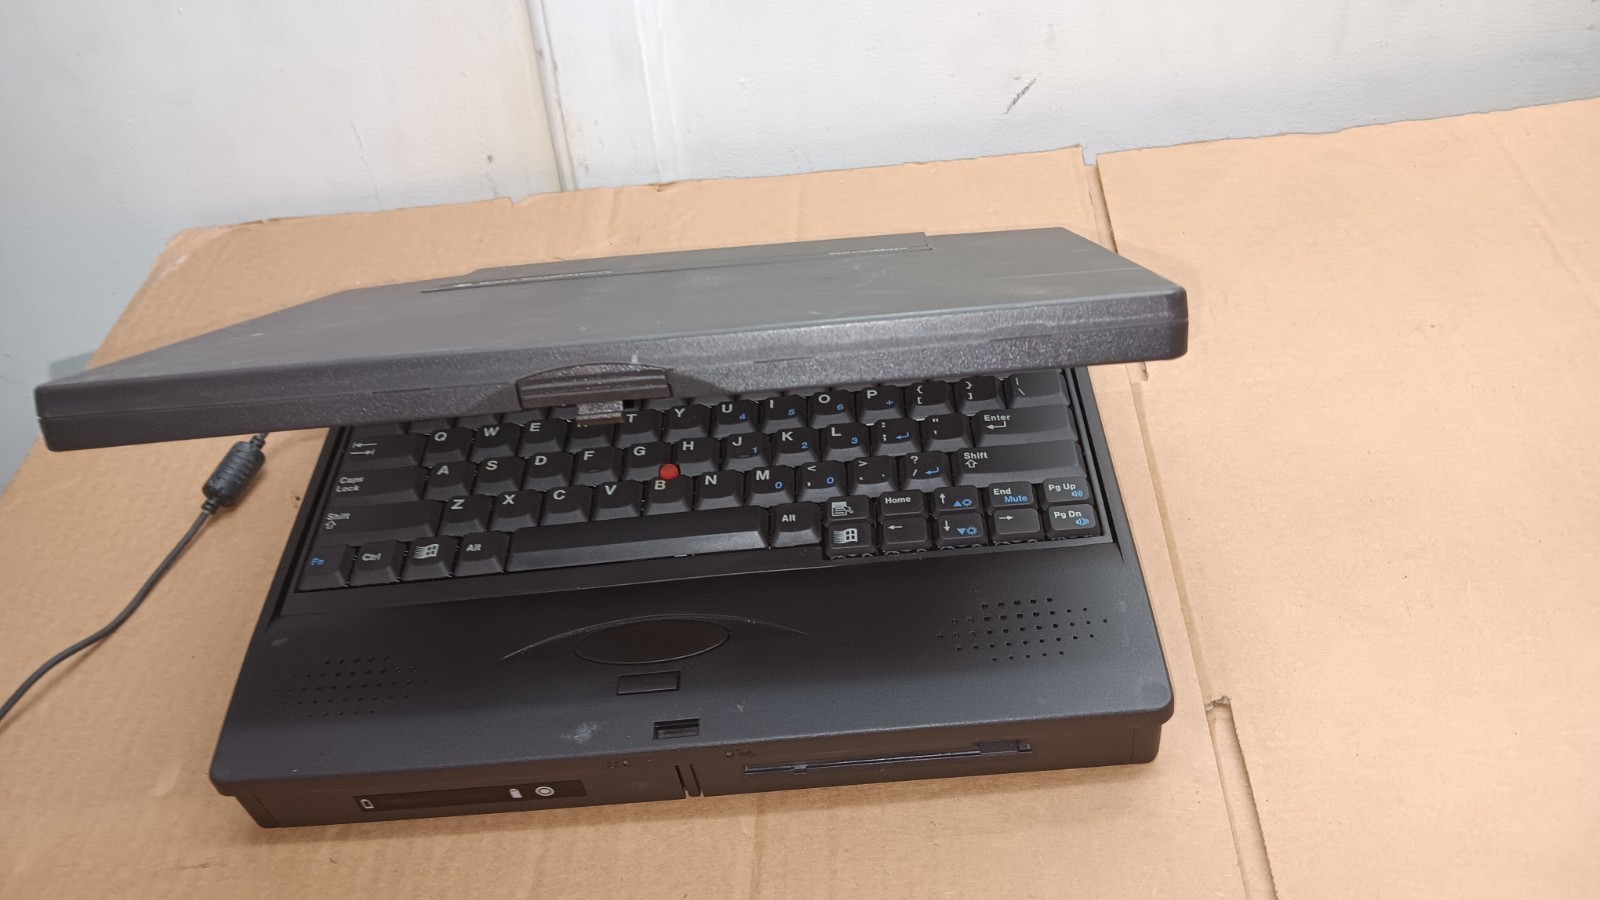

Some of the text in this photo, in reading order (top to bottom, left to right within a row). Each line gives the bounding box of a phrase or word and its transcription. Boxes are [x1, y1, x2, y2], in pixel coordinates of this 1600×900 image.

[818, 394, 831, 404] O
[866, 389, 878, 399] P
[721, 403, 733, 413] U
[769, 399, 774, 409] I
[626, 413, 637, 423] T
[674, 408, 685, 418] Y
[984, 414, 1011, 422] Enter
[483, 426, 500, 437] W
[529, 422, 542, 432] E
[831, 427, 842, 437] L
[434, 432, 447, 442] Q
[732, 436, 742, 446] J
[781, 431, 794, 441] K
[633, 446, 646, 456] G
[682, 441, 694, 451] H
[534, 455, 547, 465] D
[583, 451, 594, 461] F
[910, 455, 918, 464] ?
[963, 452, 988, 460] Shift
[436, 465, 449, 475] A
[485, 460, 498, 470] S
[339, 476, 364, 484] Caps
[704, 474, 717, 485] N
[756, 470, 770, 480] M
[605, 485, 617, 495] V
[654, 480, 666, 490] B
[1048, 483, 1076, 492] Pg Up
[553, 489, 566, 500] C
[993, 487, 1011, 496] End
[450, 499, 464, 510] Z
[502, 494, 516, 505] X
[885, 496, 911, 504] Home
[1004, 495, 1028, 504] Mute
[326, 512, 351, 521] Shift
[781, 514, 796, 522] Alt
[1054, 510, 1082, 519] Pg Dn
